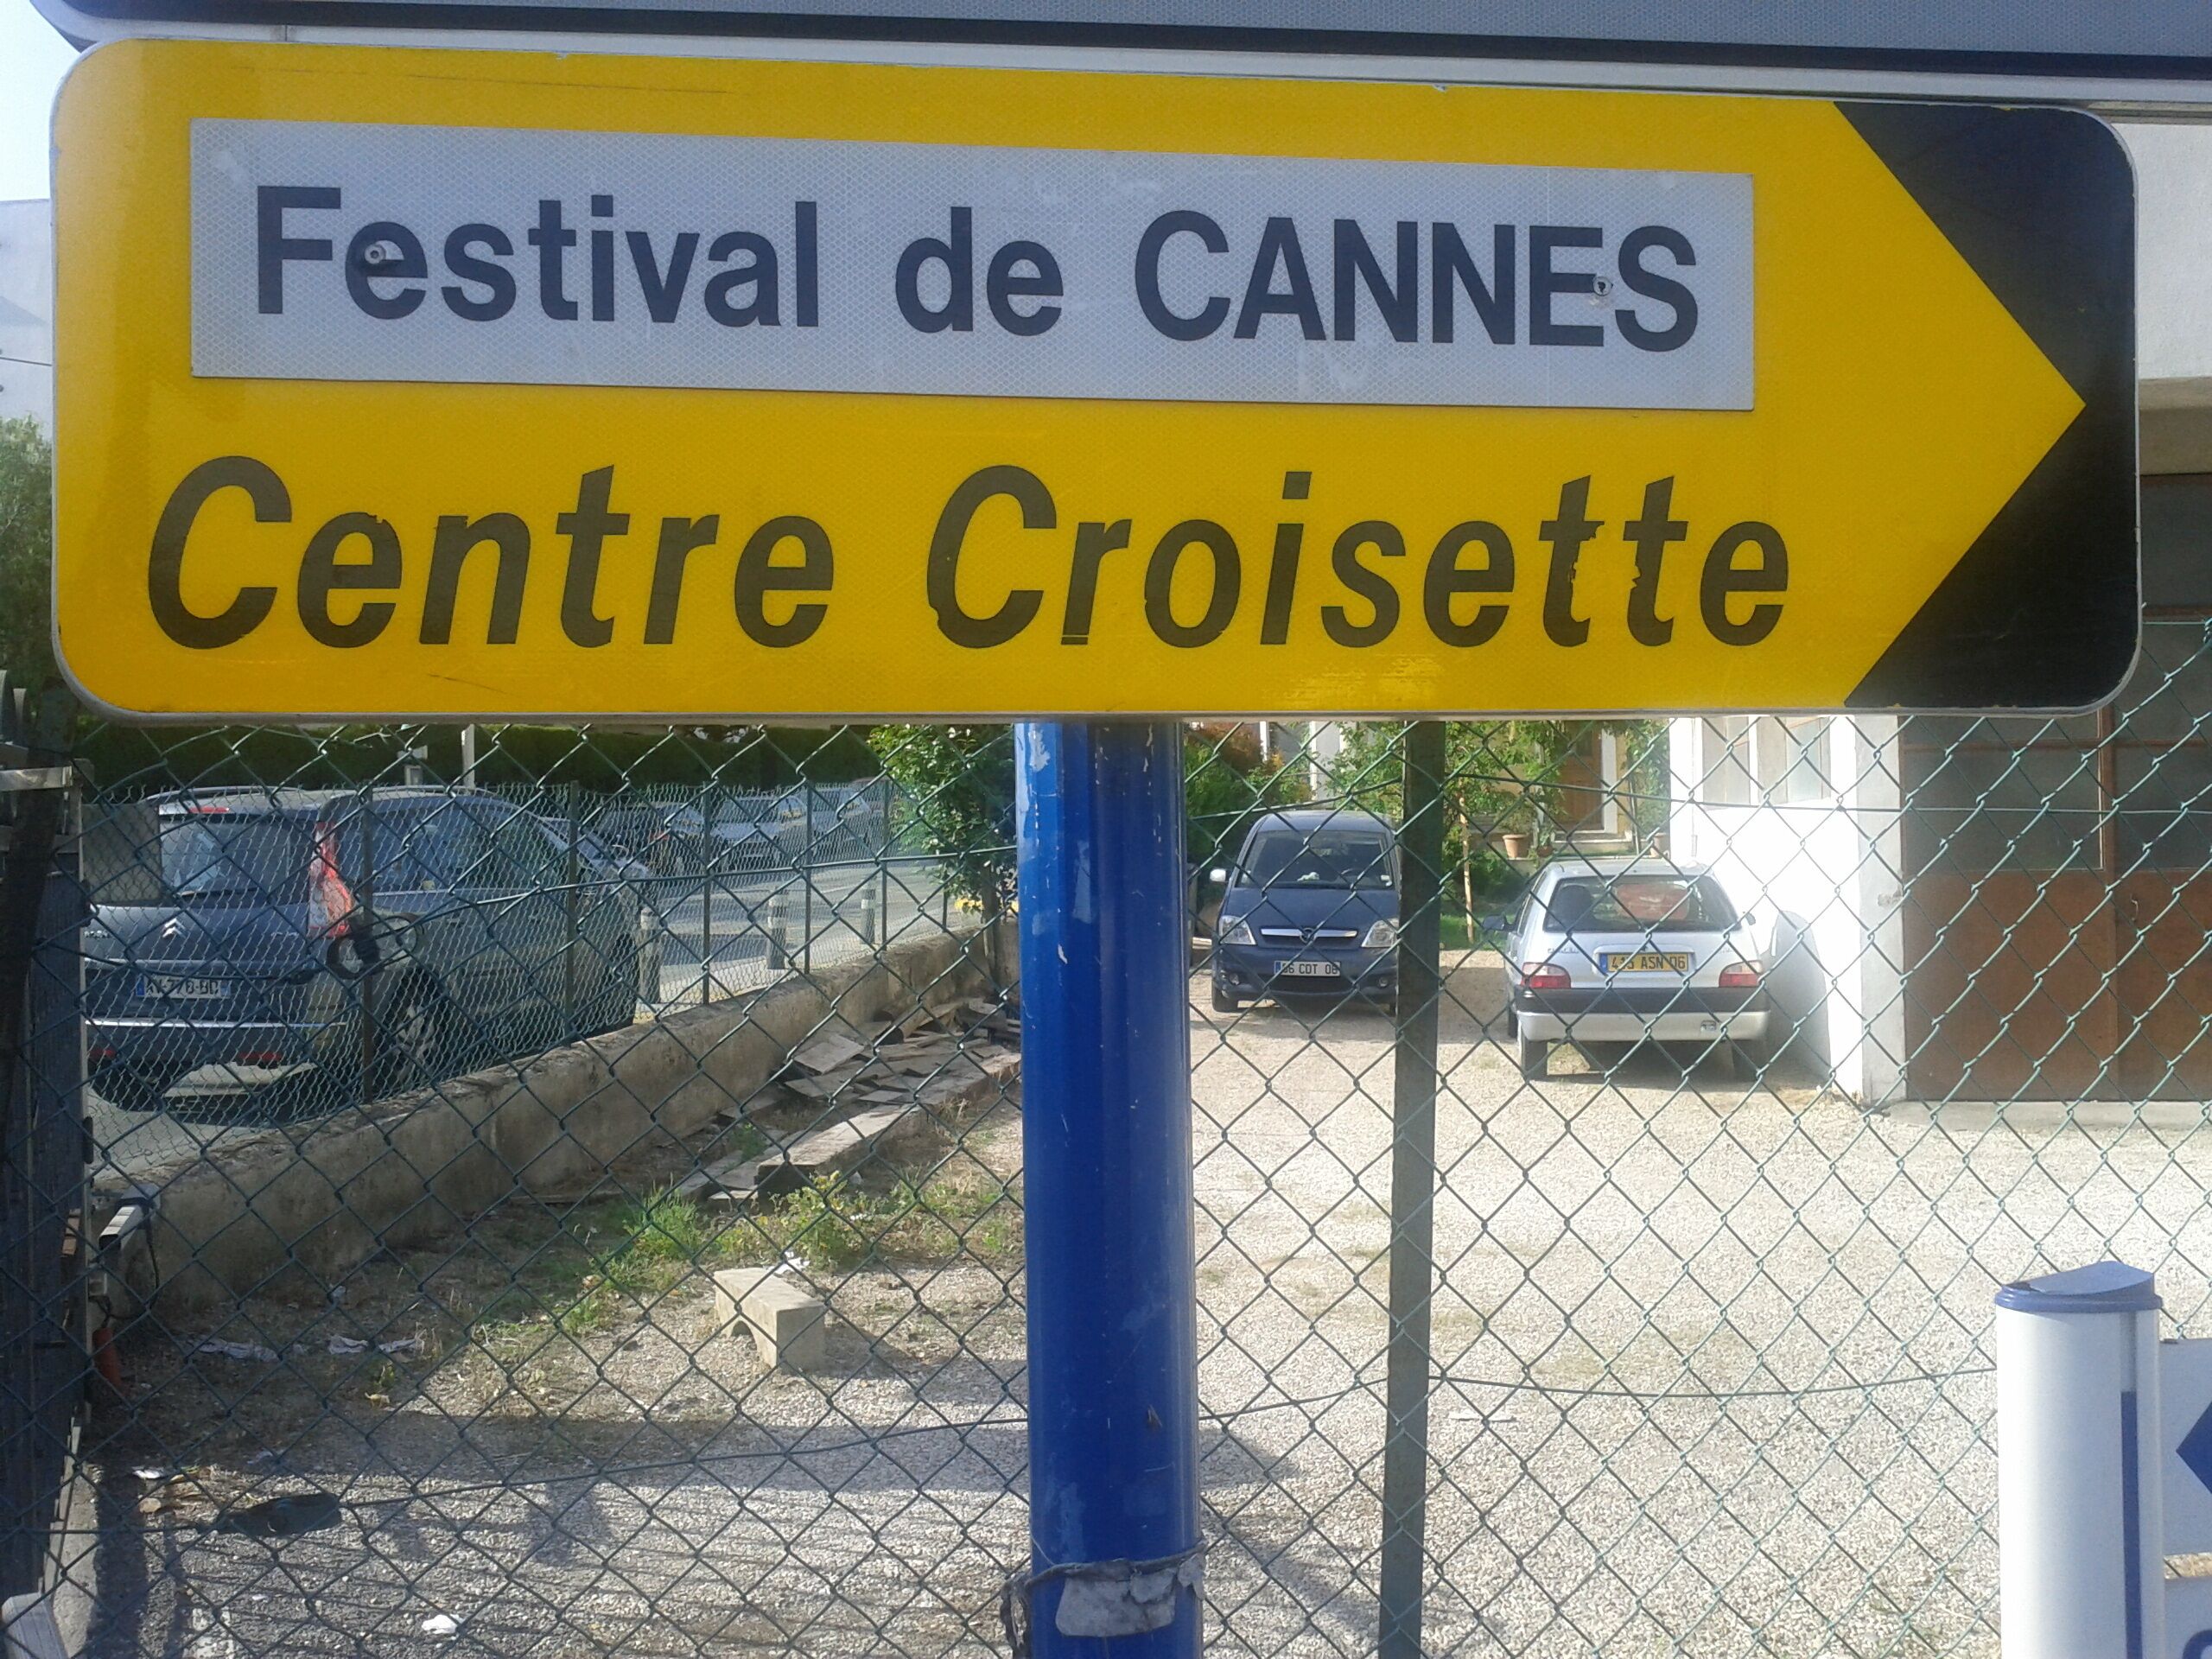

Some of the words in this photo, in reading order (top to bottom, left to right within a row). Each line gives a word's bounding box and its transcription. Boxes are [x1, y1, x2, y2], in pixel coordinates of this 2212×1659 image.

[257, 185, 819, 328] Festival
[894, 206, 1065, 336] de
[1134, 209, 1700, 353] CANNES
[148, 455, 835, 650] Centre
[926, 464, 1789, 649] Croisette
[1299, 963, 1318, 975] CDT
[1641, 957, 1663, 969] ASN
